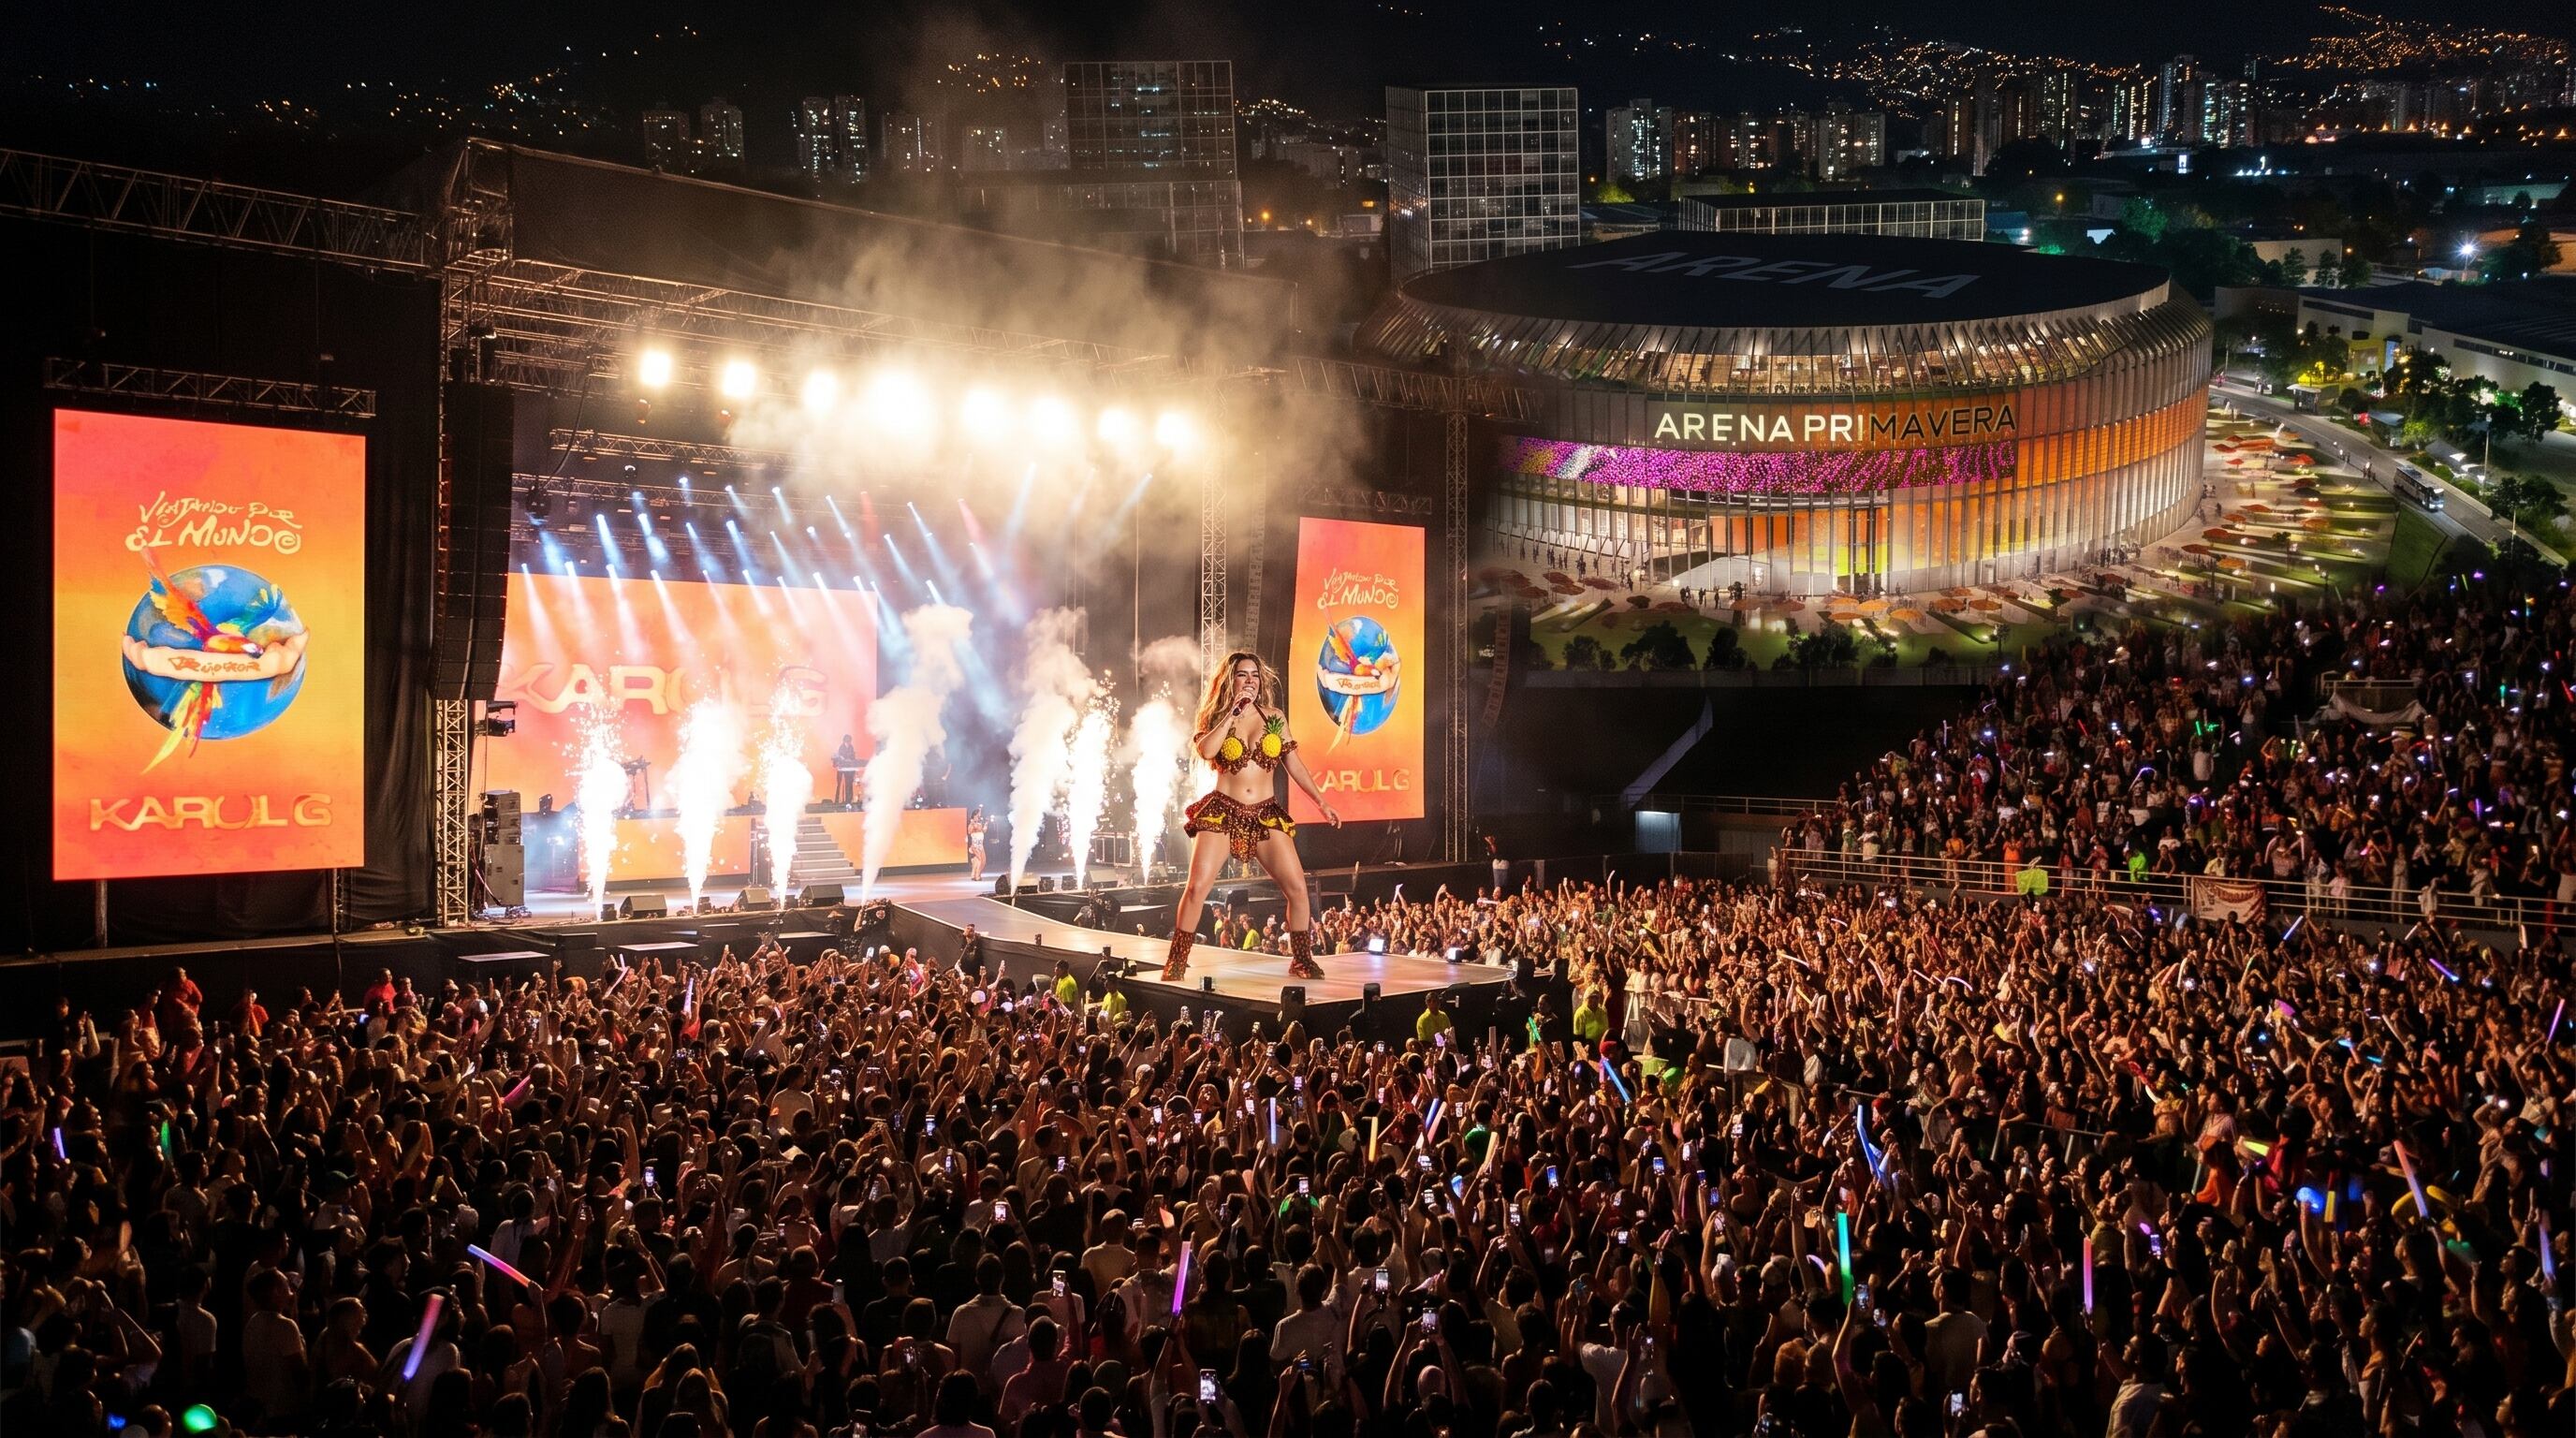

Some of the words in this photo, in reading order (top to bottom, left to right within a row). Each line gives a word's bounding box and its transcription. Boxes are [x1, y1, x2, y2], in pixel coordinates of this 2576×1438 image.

[1565, 251, 1982, 299] ARENA
[1654, 412, 1794, 442] ARENA
[1805, 404, 2016, 442] PRIMAVERA
[125, 525, 172, 551] EL
[178, 515, 301, 554] MUNDO
[1340, 583, 1399, 609] MUNDO
[1393, 768, 1410, 791] G
[293, 793, 332, 827] G
